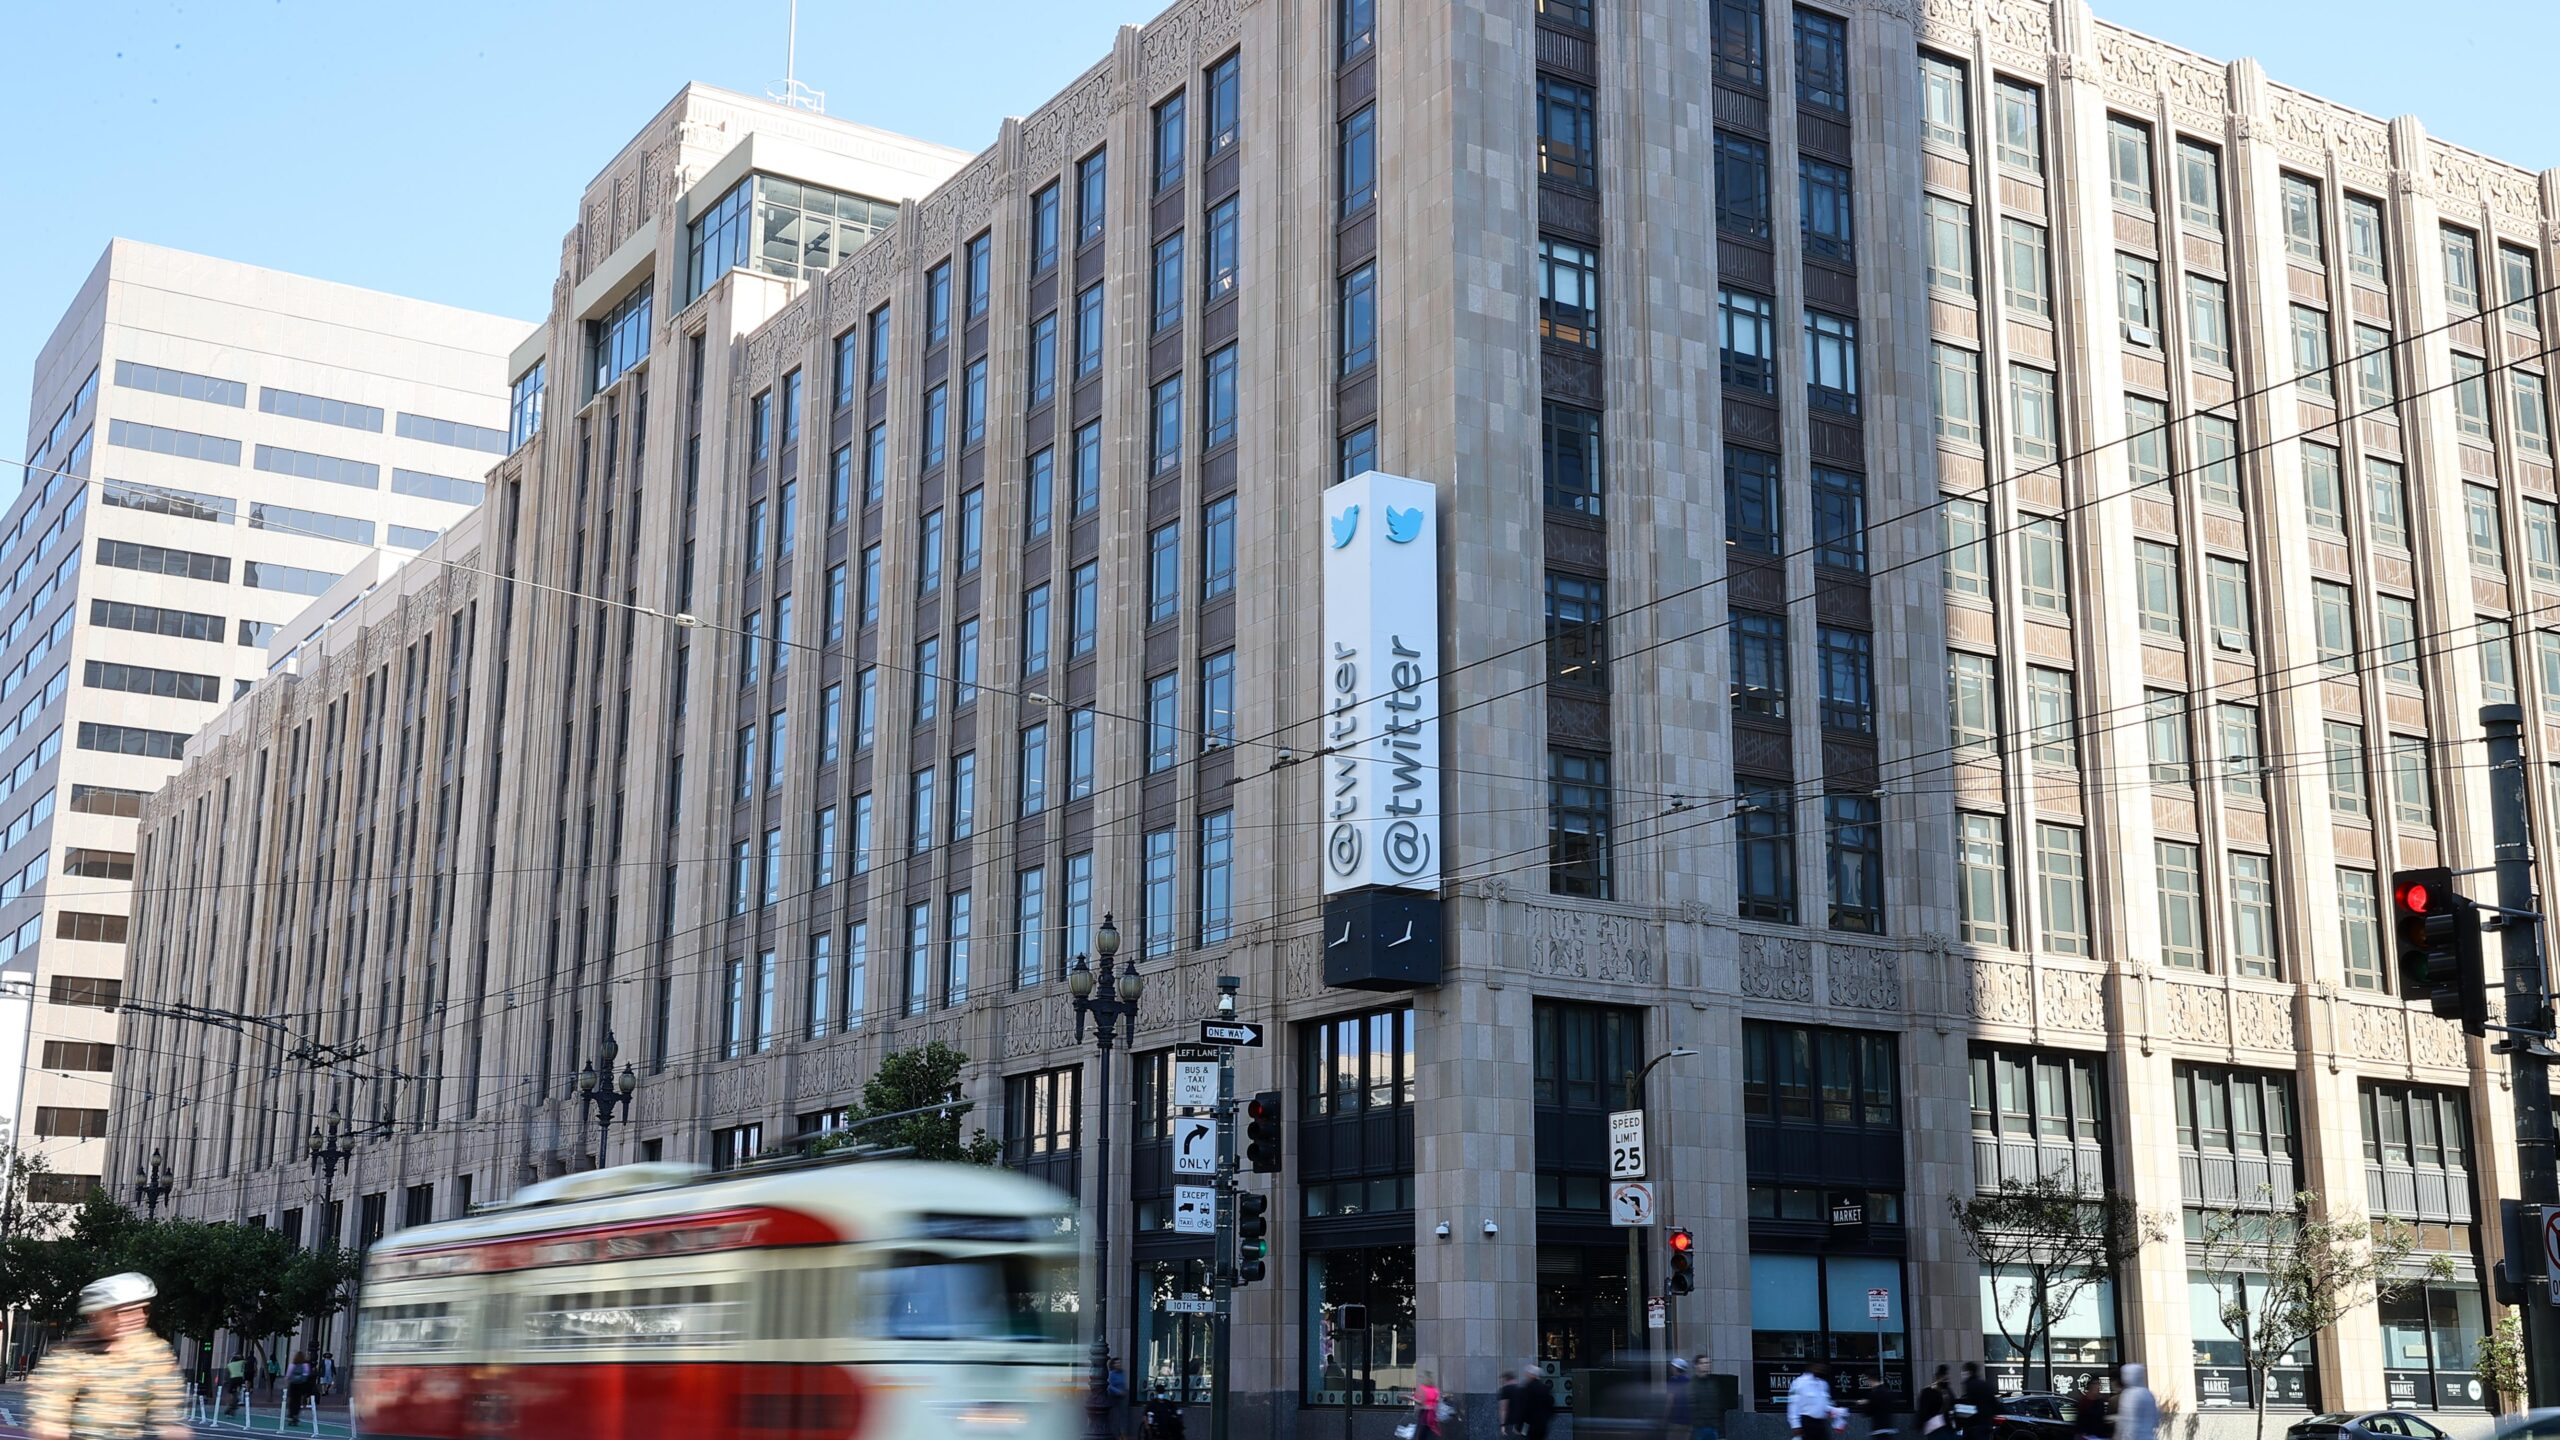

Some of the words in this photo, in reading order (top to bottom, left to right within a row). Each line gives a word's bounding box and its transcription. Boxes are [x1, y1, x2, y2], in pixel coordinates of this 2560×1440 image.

[1329, 642, 1362, 876] @twitter
[1383, 635, 1430, 876] @twitter
[1208, 1028, 1225, 1037] ONE
[1228, 1030, 1245, 1038] WAY
[1177, 1049, 1195, 1057] LEFT
[1197, 1049, 1218, 1057] LANE
[1184, 1066, 1200, 1074] BUS
[1202, 1066, 1209, 1074] &
[1188, 1075, 1205, 1083] TAXI
[1612, 1117, 1640, 1130] SPEED
[1615, 1132, 1638, 1144] LIMIT
[1179, 1157, 1211, 1170] ONLY
[1613, 1146, 1641, 1172] 25
[1182, 1190, 1209, 1200] EXCEPT
[1833, 1208, 1862, 1223] MARKET
[1174, 1301, 1192, 1310] 10TH
[1197, 1302, 1206, 1311] ST
[1997, 1378, 2023, 1391] MARKE
[2203, 1380, 2230, 1393] MARKET
[2390, 1383, 2415, 1395] MARKET
